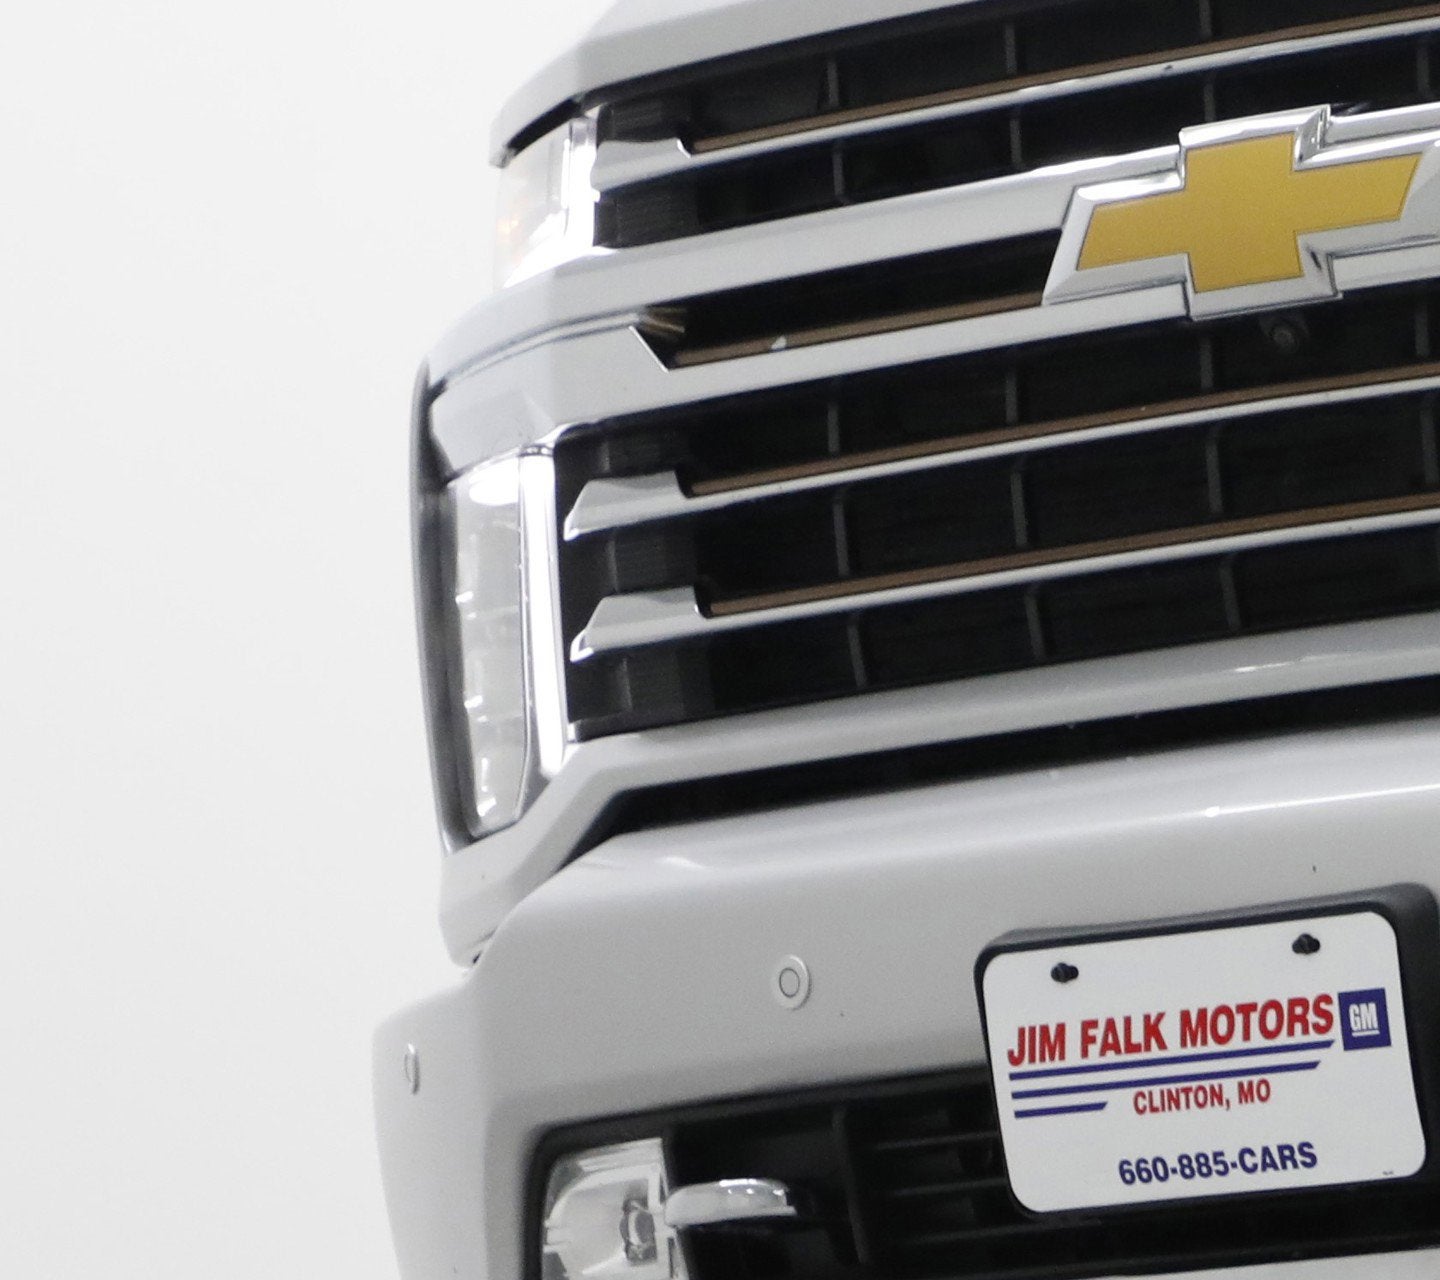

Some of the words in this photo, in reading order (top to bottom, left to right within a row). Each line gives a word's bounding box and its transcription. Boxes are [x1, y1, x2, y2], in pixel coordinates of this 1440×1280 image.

[1008, 1023, 1066, 1067] JIM
[1080, 1012, 1167, 1058] FALK
[1180, 994, 1334, 1048] MOTORS
[1348, 1001, 1379, 1035] GM
[1133, 1086, 1231, 1116] CLINTON,
[1238, 1079, 1271, 1104] MO
[1119, 1141, 1318, 1186] 660-885-CARS
